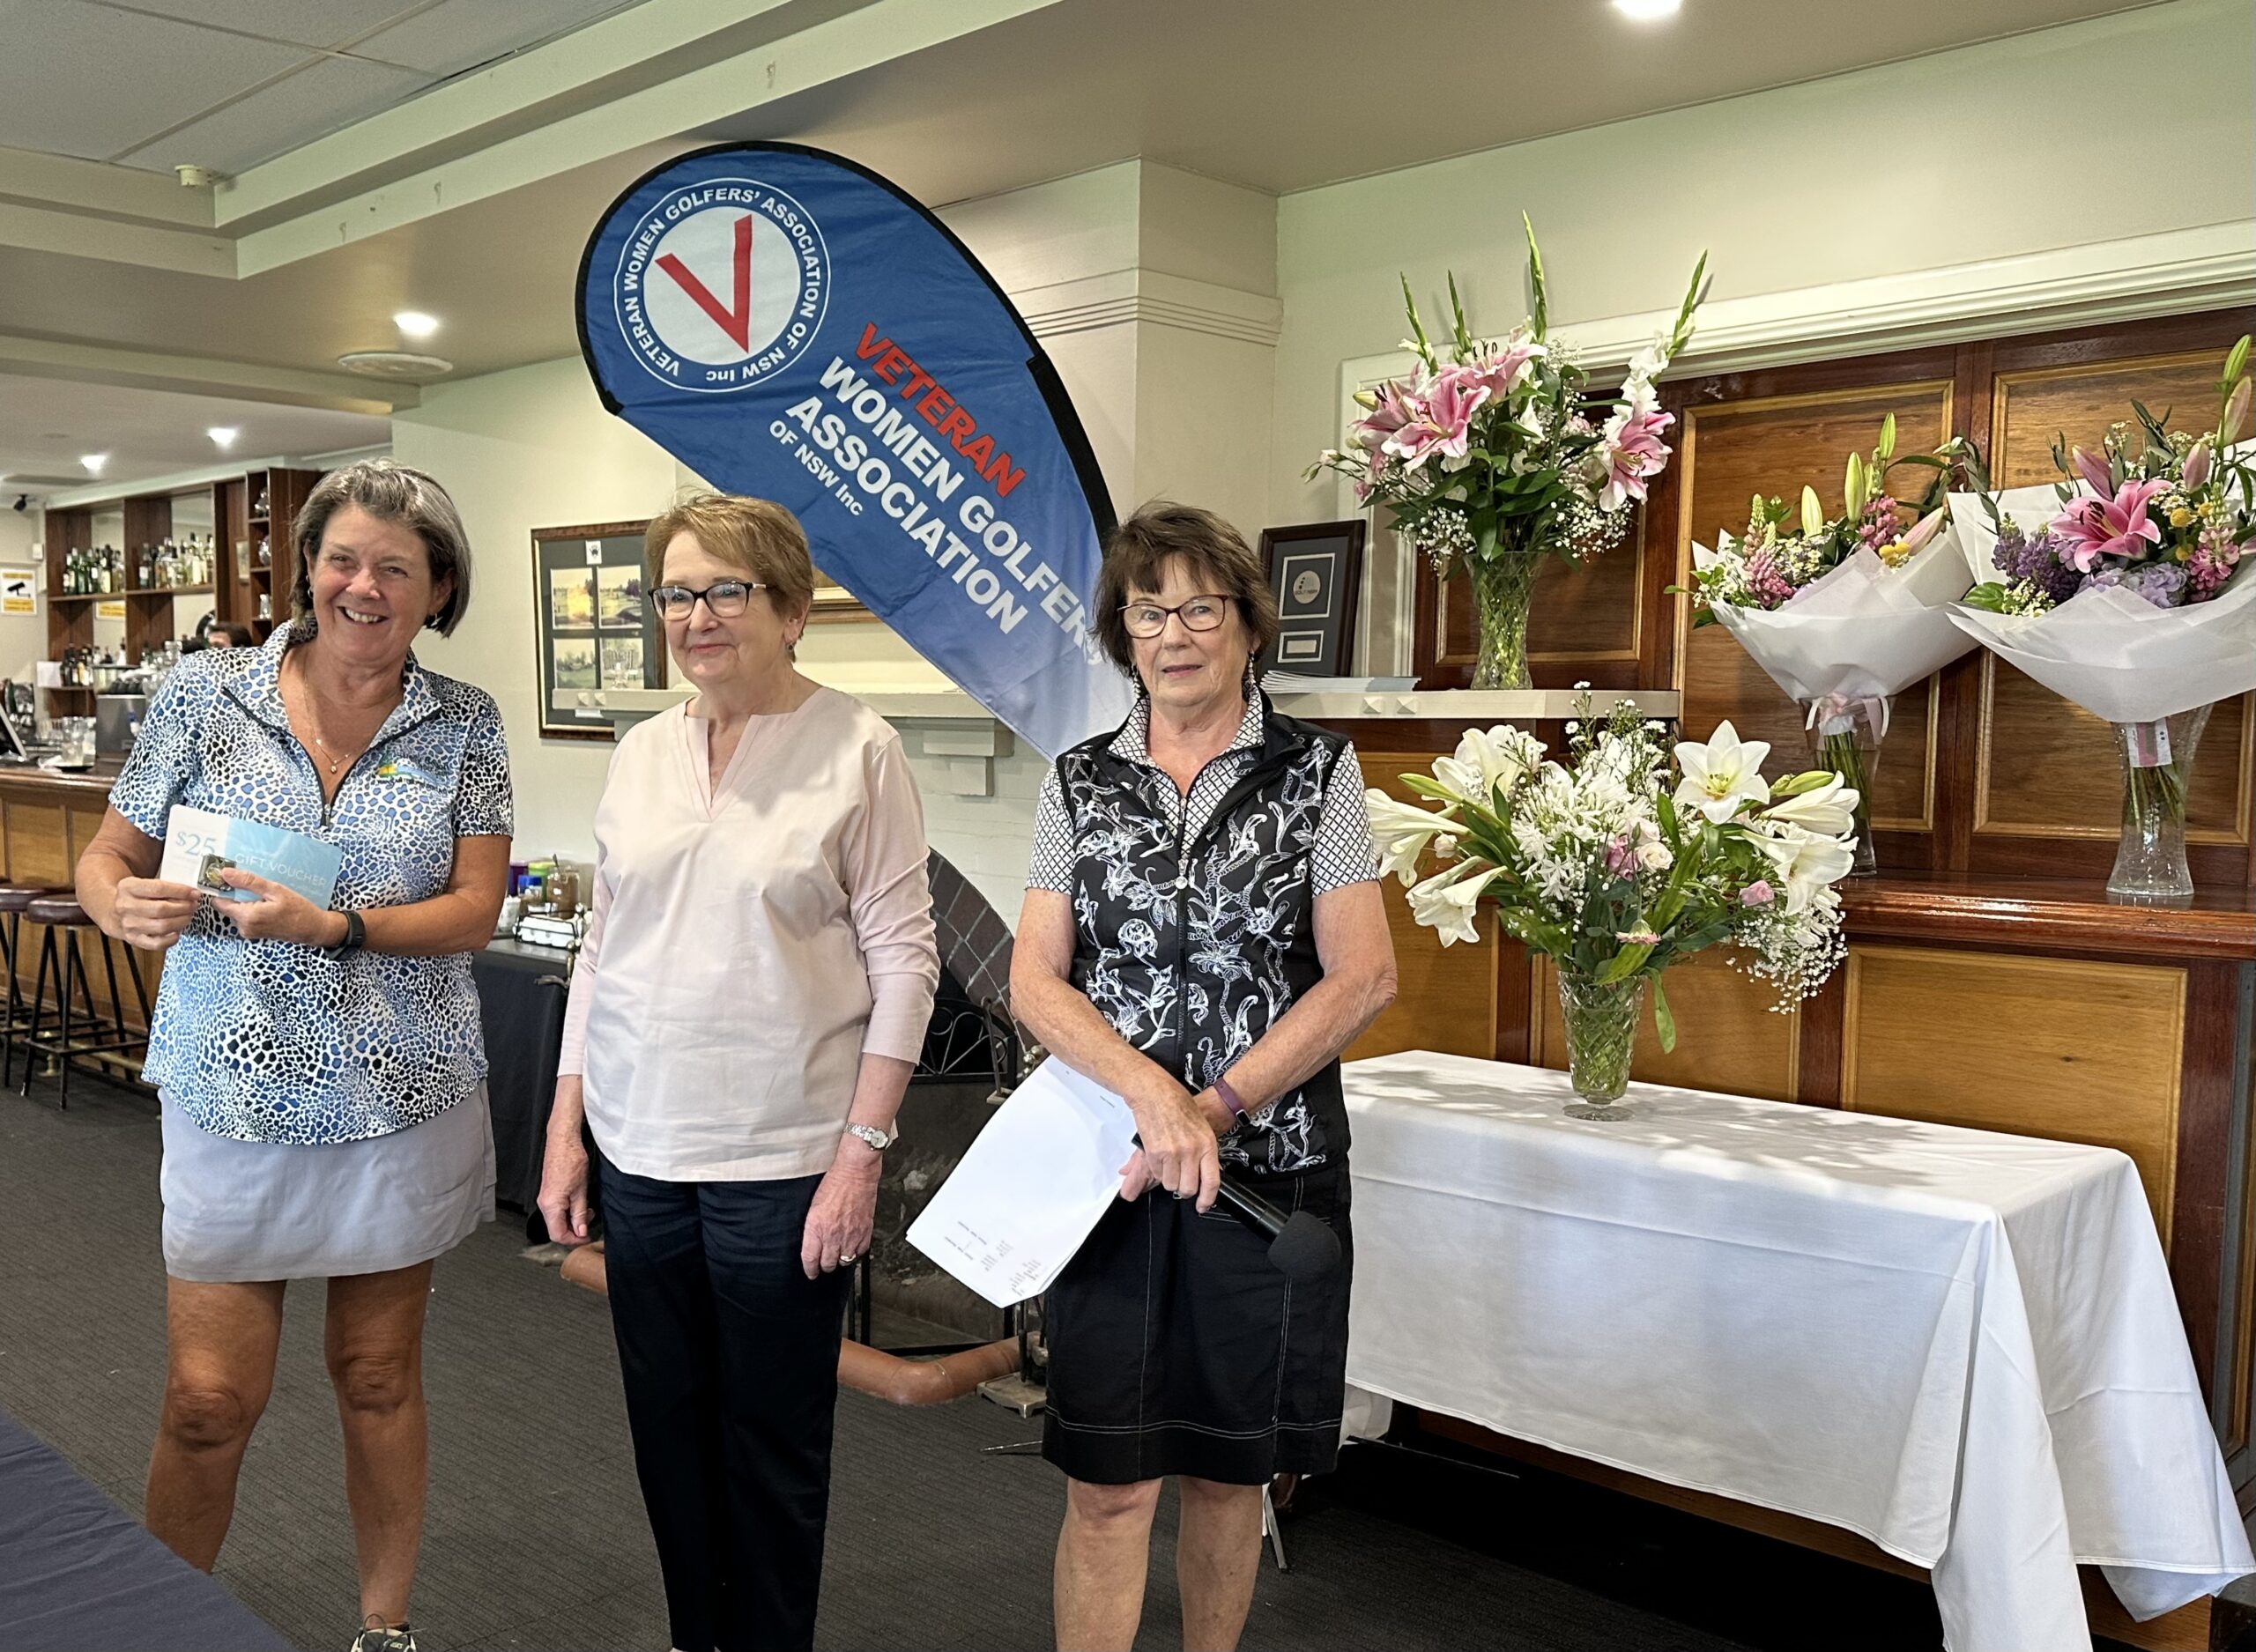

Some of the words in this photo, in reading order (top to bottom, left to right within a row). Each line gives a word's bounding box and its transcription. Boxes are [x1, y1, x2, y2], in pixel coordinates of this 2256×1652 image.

[624, 218, 665, 292] WOMEN
[761, 197, 820, 318] ASSOCIATION
[624, 296, 680, 377] VETERAN
[742, 347, 786, 379] NSW
[787, 322, 807, 350] OF
[706, 369, 735, 382] Inc
[855, 321, 1027, 499] VETERAN
[819, 355, 965, 502] WOMEN
[769, 419, 798, 446] OF
[794, 443, 840, 488] NSW
[835, 483, 863, 516] Inc
[784, 396, 1028, 634] ASSOCIATION
[176, 830, 216, 857] $25
[235, 852, 265, 869] GIFT
[268, 861, 327, 887] VOUCHER
